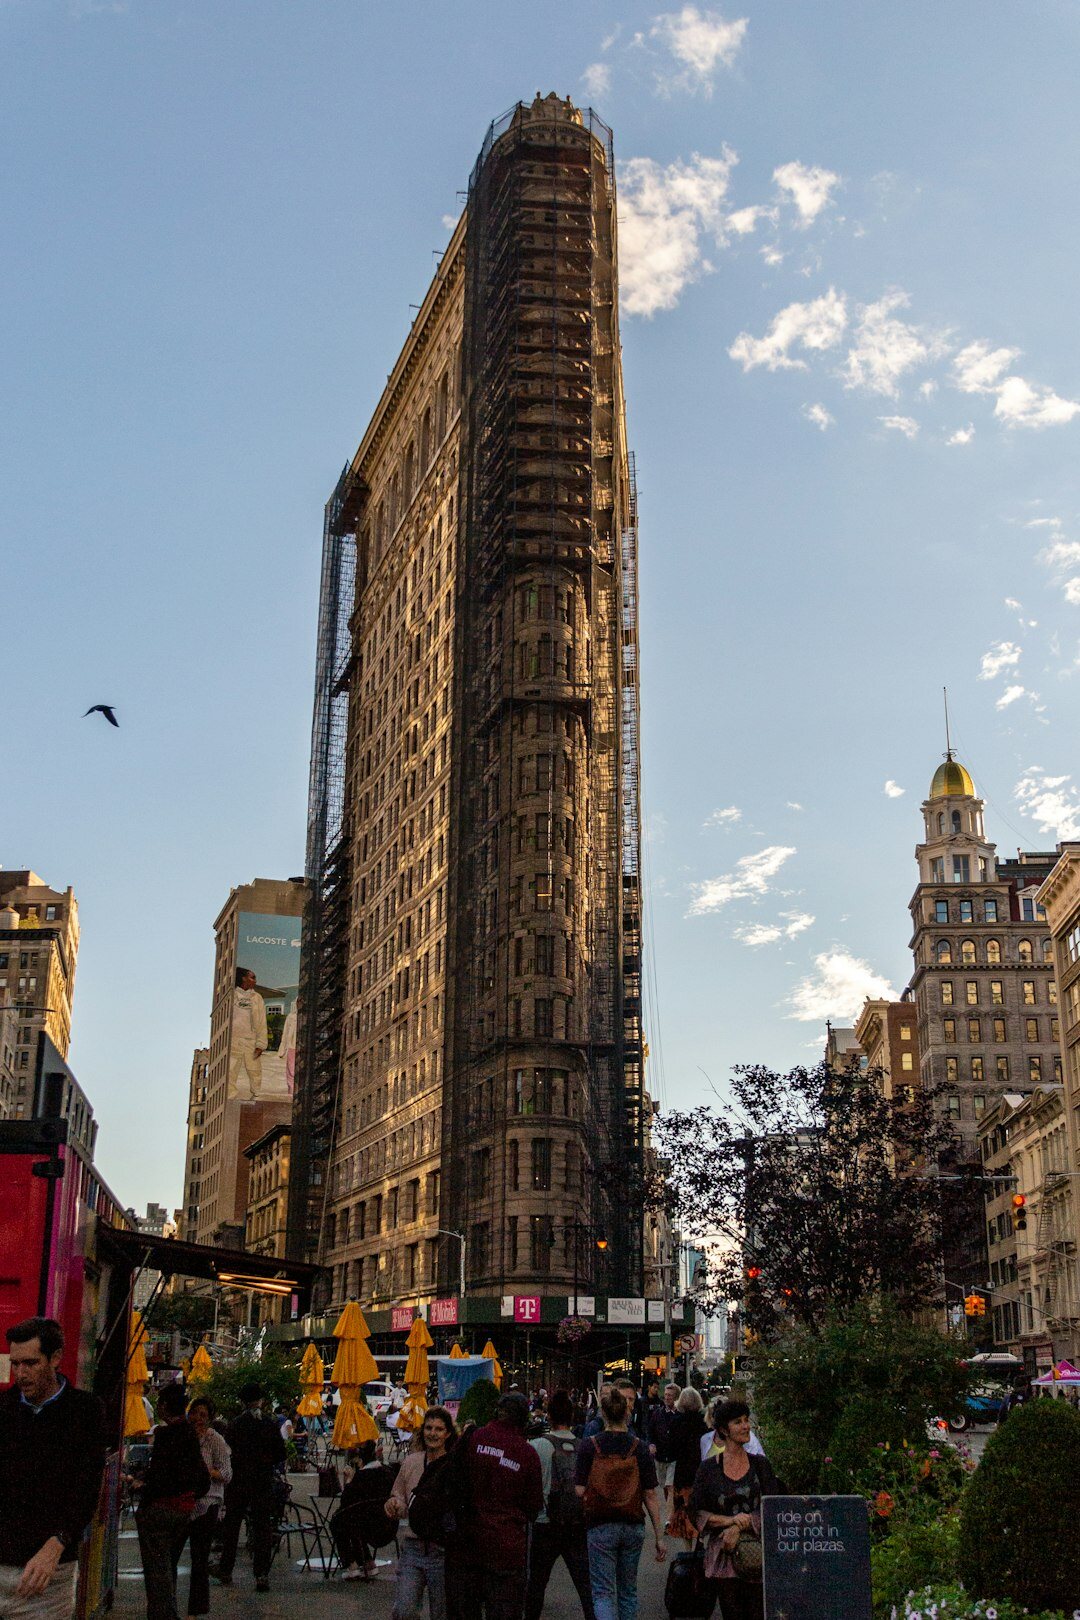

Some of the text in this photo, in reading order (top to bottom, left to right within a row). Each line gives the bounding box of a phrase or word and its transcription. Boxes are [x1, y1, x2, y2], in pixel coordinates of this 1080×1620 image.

[246, 935, 287, 946] LACOSTE
[519, 1299, 536, 1319] T
[476, 1444, 504, 1457] FLATIRON
[499, 1457, 520, 1471] NOMAD
[777, 1510, 802, 1523] ride
[777, 1524, 839, 1540] just not in
[777, 1540, 800, 1552] our
